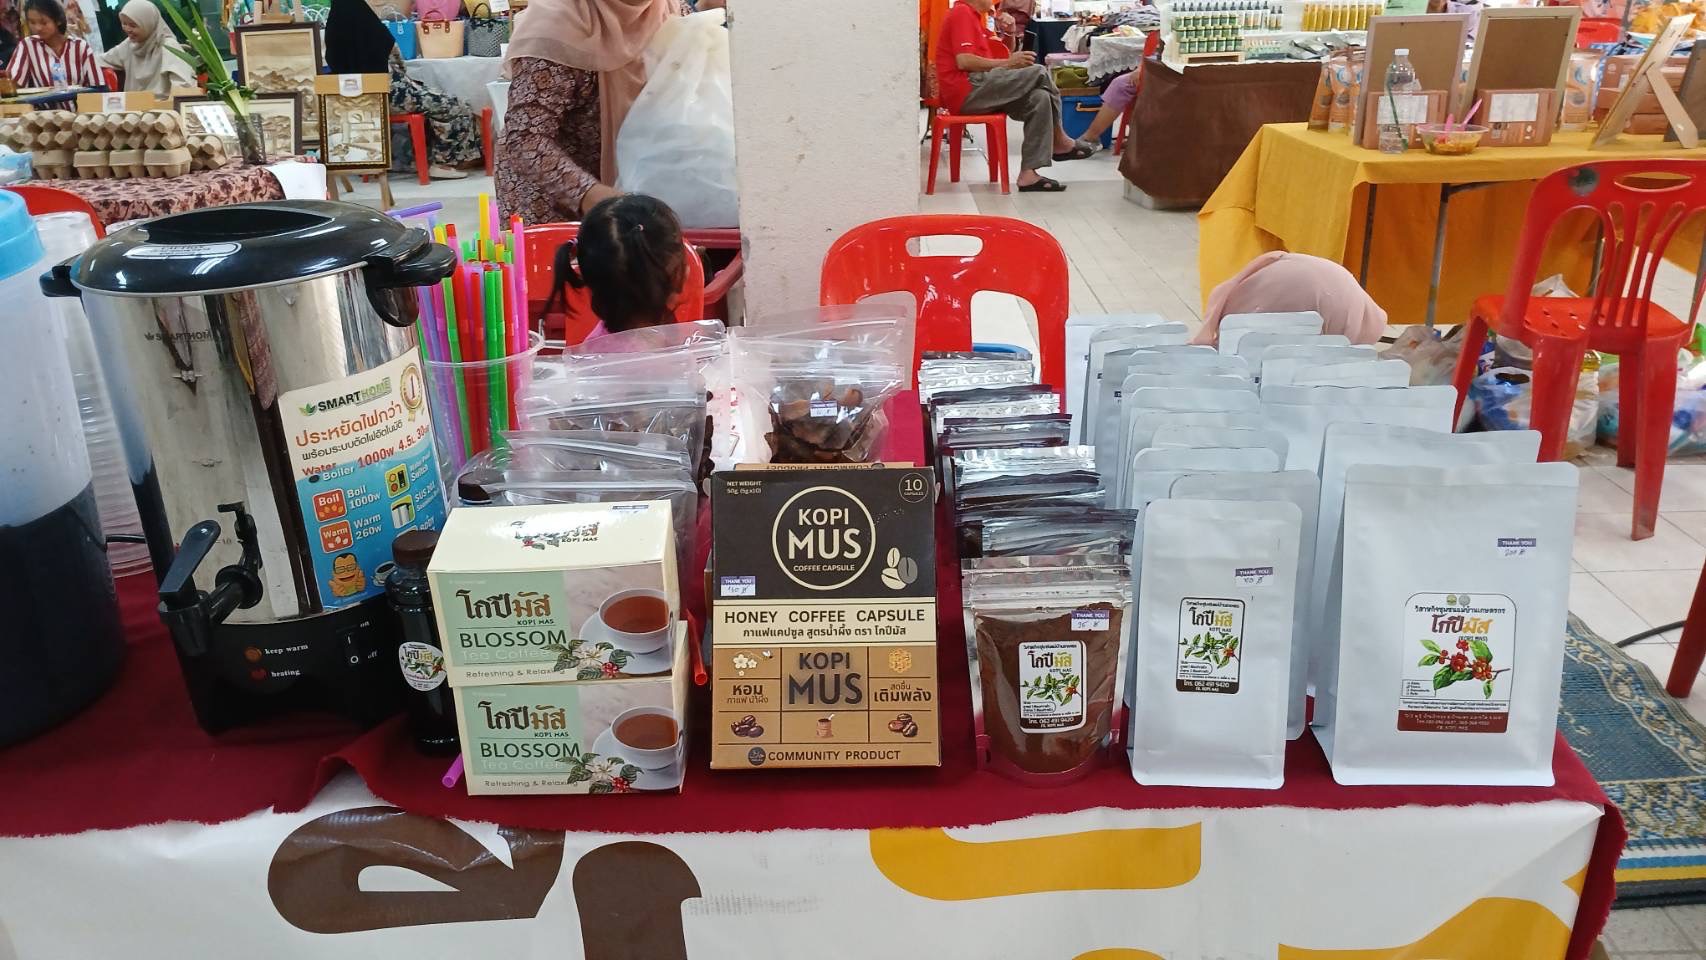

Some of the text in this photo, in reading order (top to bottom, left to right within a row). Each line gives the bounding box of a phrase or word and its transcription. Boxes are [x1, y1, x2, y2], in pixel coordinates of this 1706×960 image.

[318, 377, 392, 411] SMARTHOME
[296, 401, 402, 447] ประหยัดไฟกว่า
[302, 462, 355, 481] Water Boiler
[347, 487, 366, 499] Boil
[905, 479, 923, 491] 10
[318, 494, 340, 506] Boil
[354, 513, 381, 529] Warm
[799, 508, 849, 526] KOPI
[323, 526, 348, 539] Warm
[356, 526, 382, 540] 260w
[788, 528, 862, 560] MUS
[455, 589, 552, 619] โกปีมัส
[724, 610, 925, 624] HONEY COFFEE CAPSULE
[459, 630, 567, 648] BLOSSOM
[743, 624, 907, 639] กาแฟแคปซูล สูตรน้ำผึ้ง ตรา โกปีมัส
[286, 643, 308, 652] warm
[799, 652, 850, 670] KOPI
[732, 684, 763, 696] หอม
[788, 673, 863, 705] MUS
[873, 687, 932, 703] เติมพลัง
[478, 701, 567, 730] โกปีมัส
[480, 742, 580, 758] BLOSSOM
[768, 751, 839, 761] COMMUNITY
[845, 750, 901, 760] PRODUCT
[485, 780, 530, 788] Refreshing
